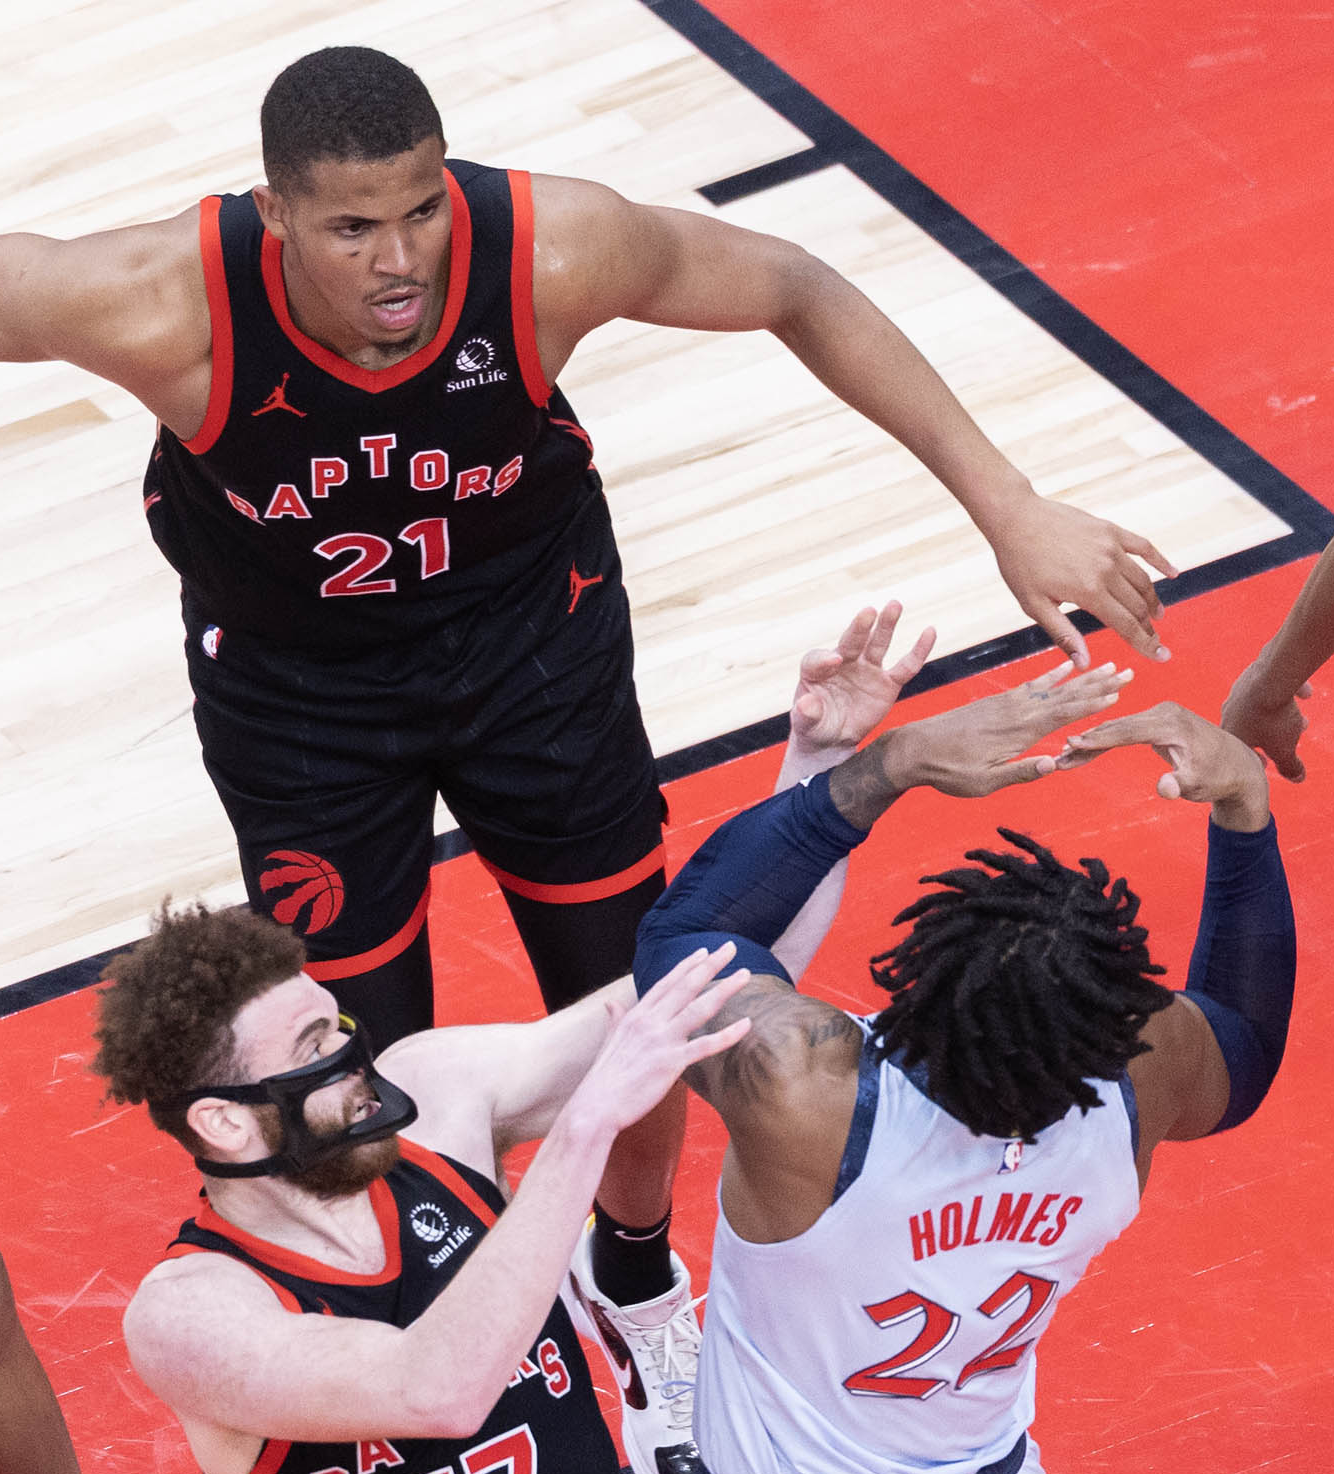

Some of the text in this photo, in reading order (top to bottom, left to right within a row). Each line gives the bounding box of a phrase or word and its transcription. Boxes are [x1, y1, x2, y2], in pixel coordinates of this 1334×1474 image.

[447, 369, 507, 392] Sun Life
[224, 434, 523, 526] RAPTORS
[313, 517, 450, 598] 21
[428, 1225, 473, 1268] Sun Life
[909, 1193, 1083, 1262] HOLMES
[842, 1270, 1060, 1400] 22
